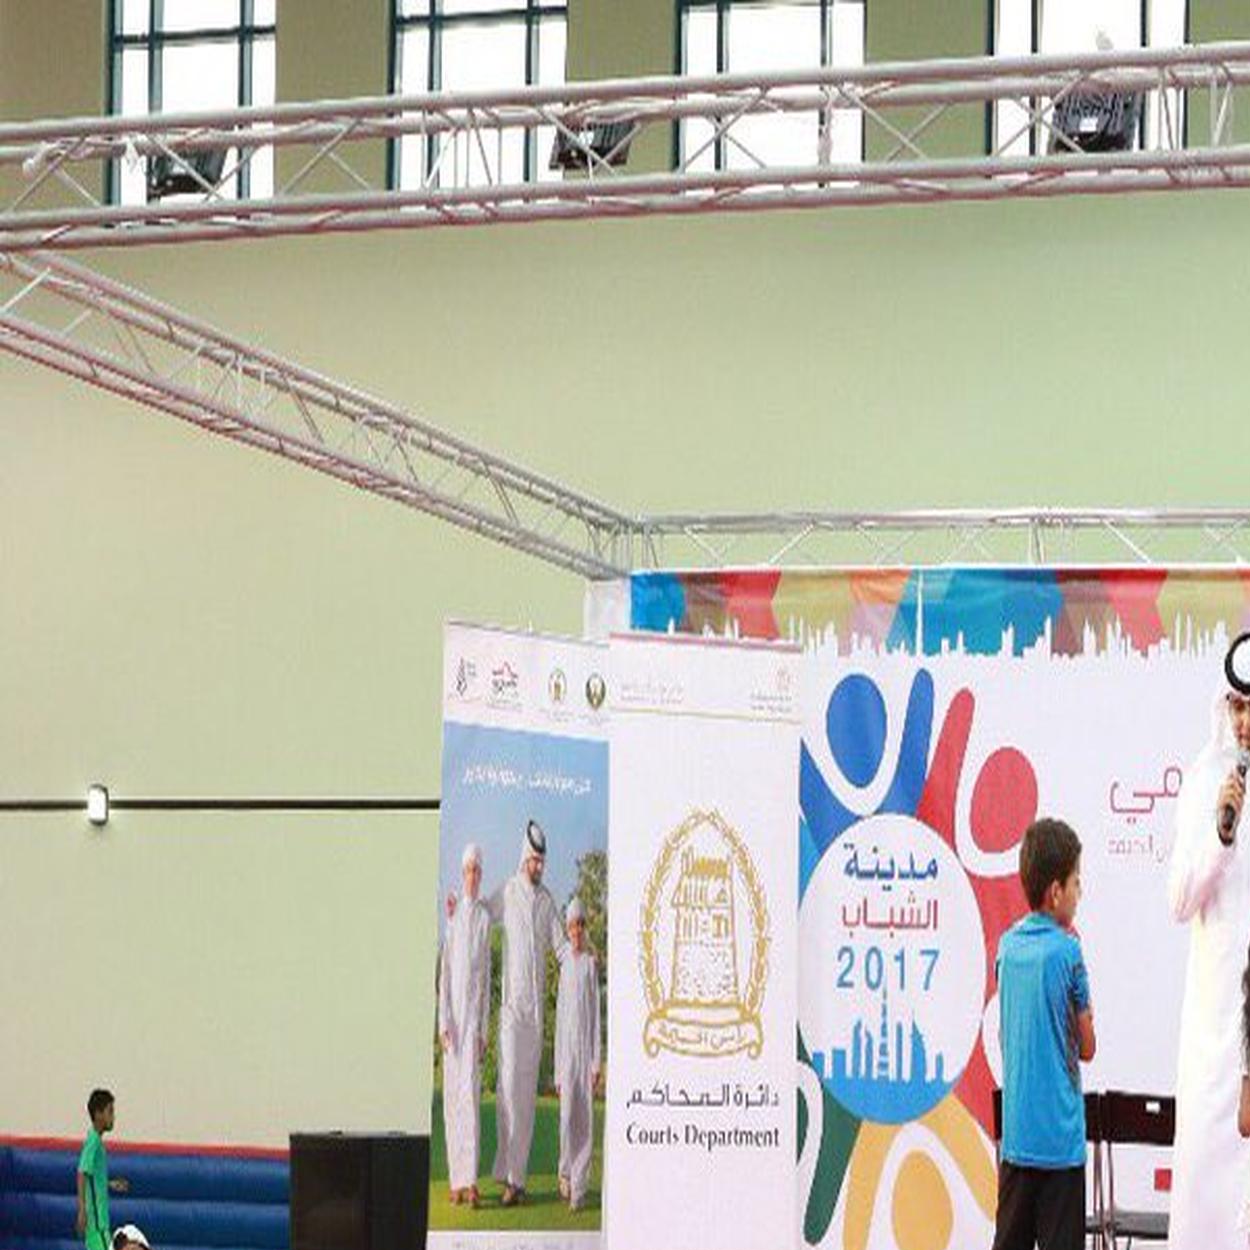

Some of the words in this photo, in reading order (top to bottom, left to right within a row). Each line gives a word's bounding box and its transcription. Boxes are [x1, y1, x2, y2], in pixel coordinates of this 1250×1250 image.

[843, 843, 938, 891] مدينة
[842, 891, 938, 938] الشباب
[836, 946, 941, 991] 2017
[626, 1083, 731, 1110] المحاكم
[733, 1083, 779, 1110] دائرة
[626, 1122, 680, 1146] Courts
[684, 1124, 780, 1151] Department
